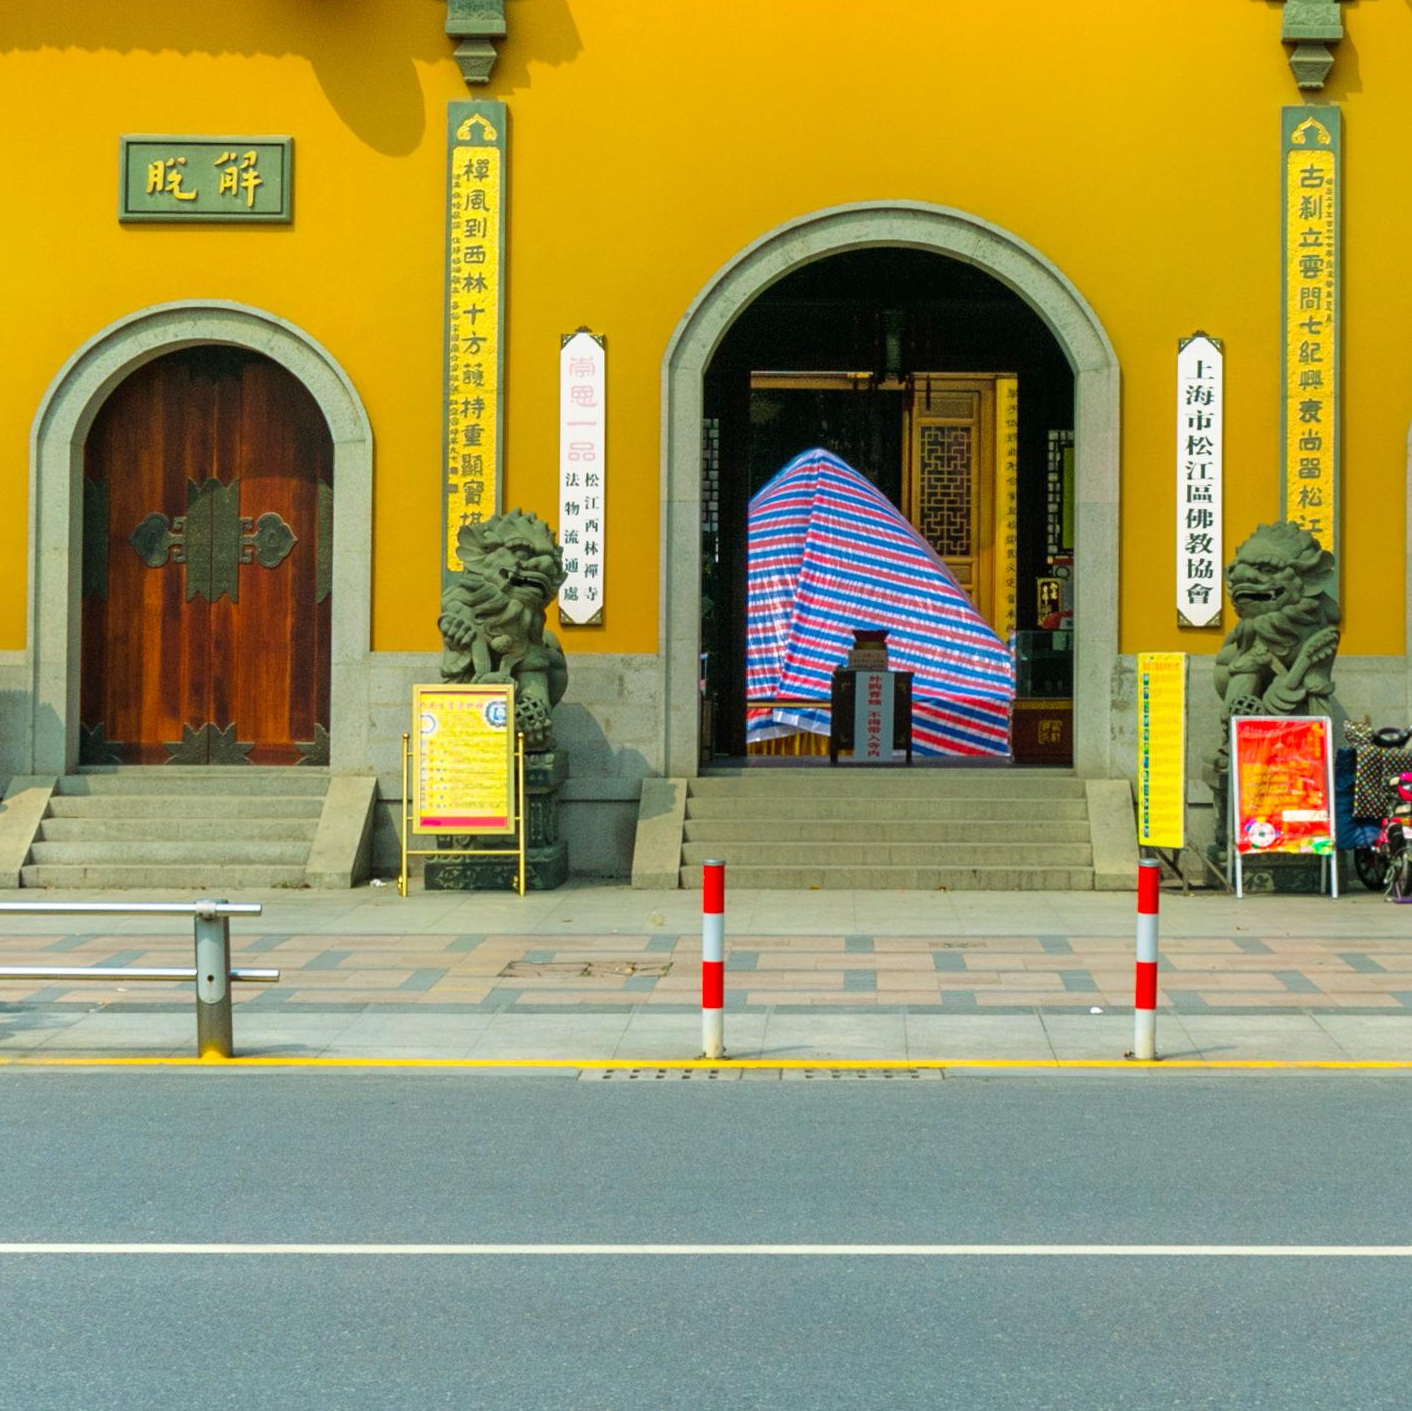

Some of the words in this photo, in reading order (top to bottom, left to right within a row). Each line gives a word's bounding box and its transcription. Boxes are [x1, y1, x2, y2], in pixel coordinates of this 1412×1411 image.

[1185, 359, 1214, 604] 上海市松江區佛教協會
